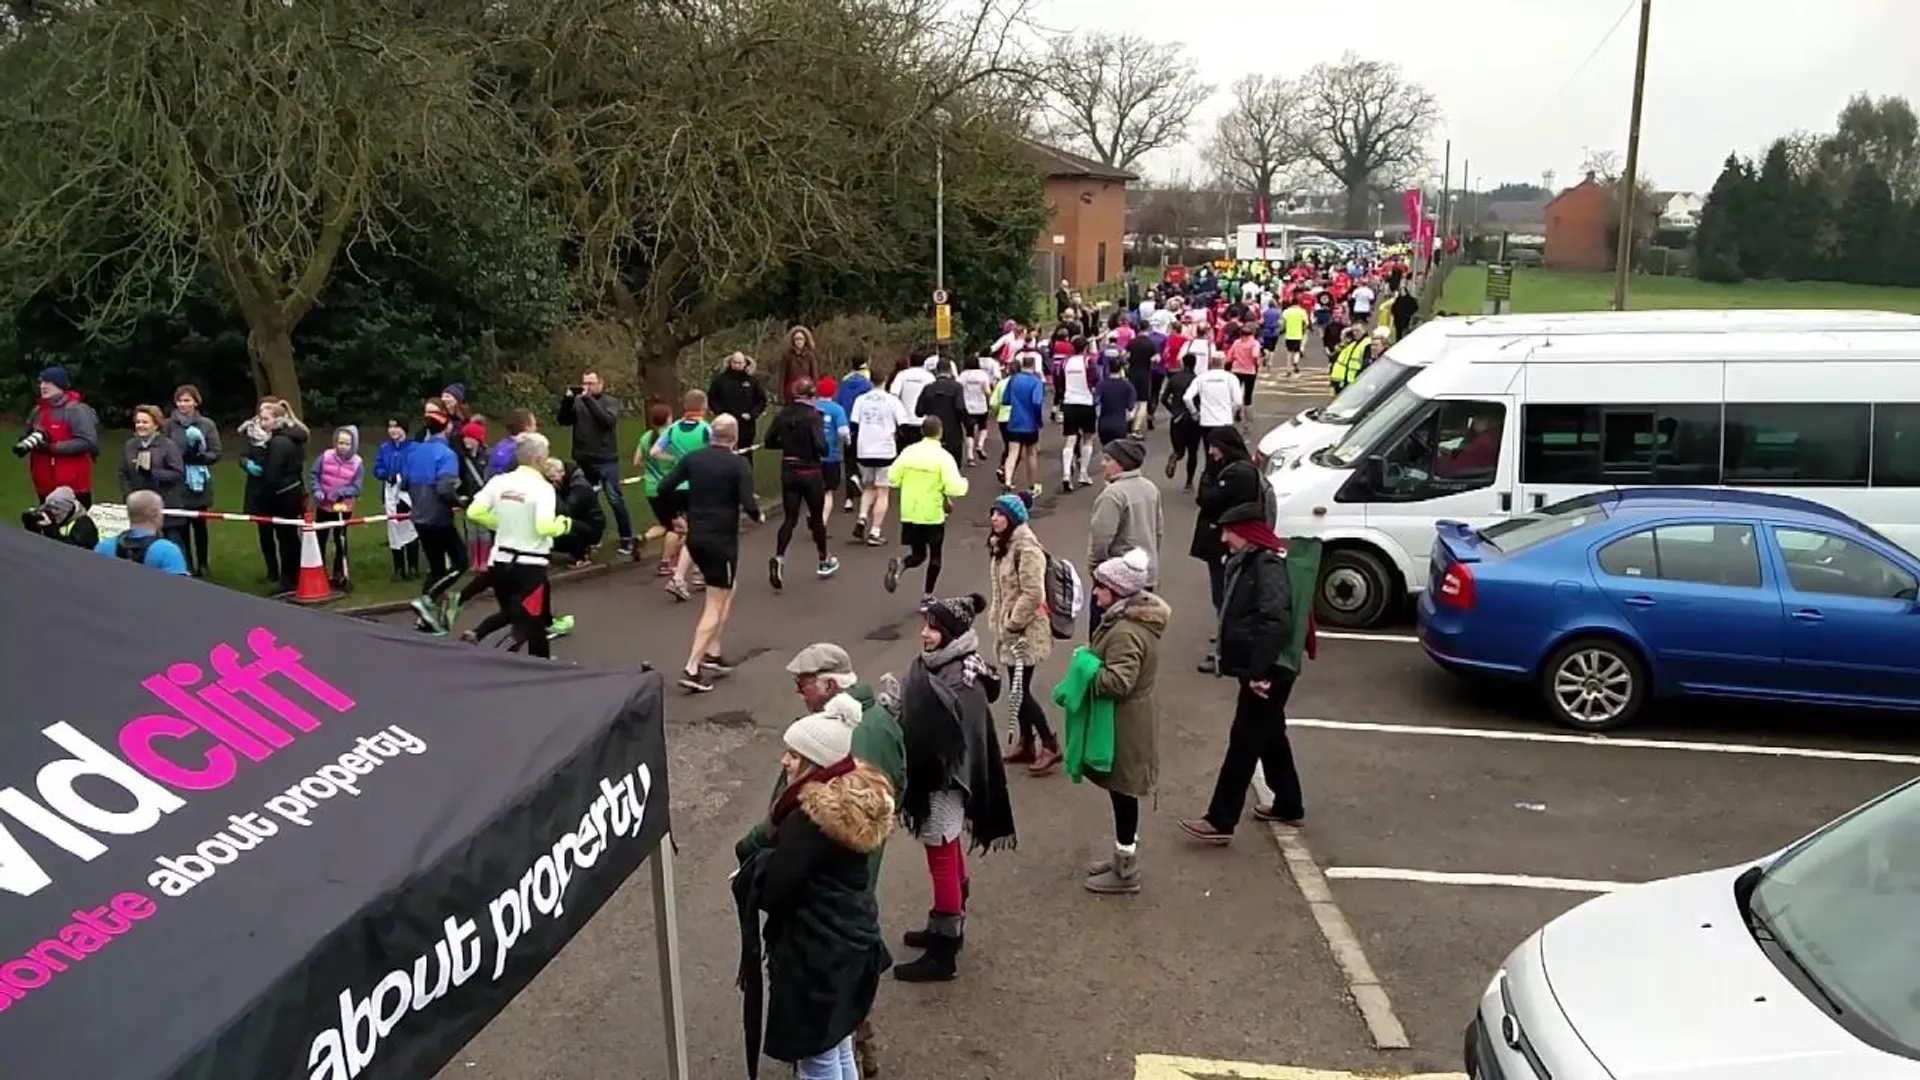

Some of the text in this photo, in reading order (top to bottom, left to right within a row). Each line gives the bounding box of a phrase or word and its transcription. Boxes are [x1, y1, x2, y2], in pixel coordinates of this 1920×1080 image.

[0, 725, 427, 1012] onate about property
[308, 763, 651, 1080] about property
